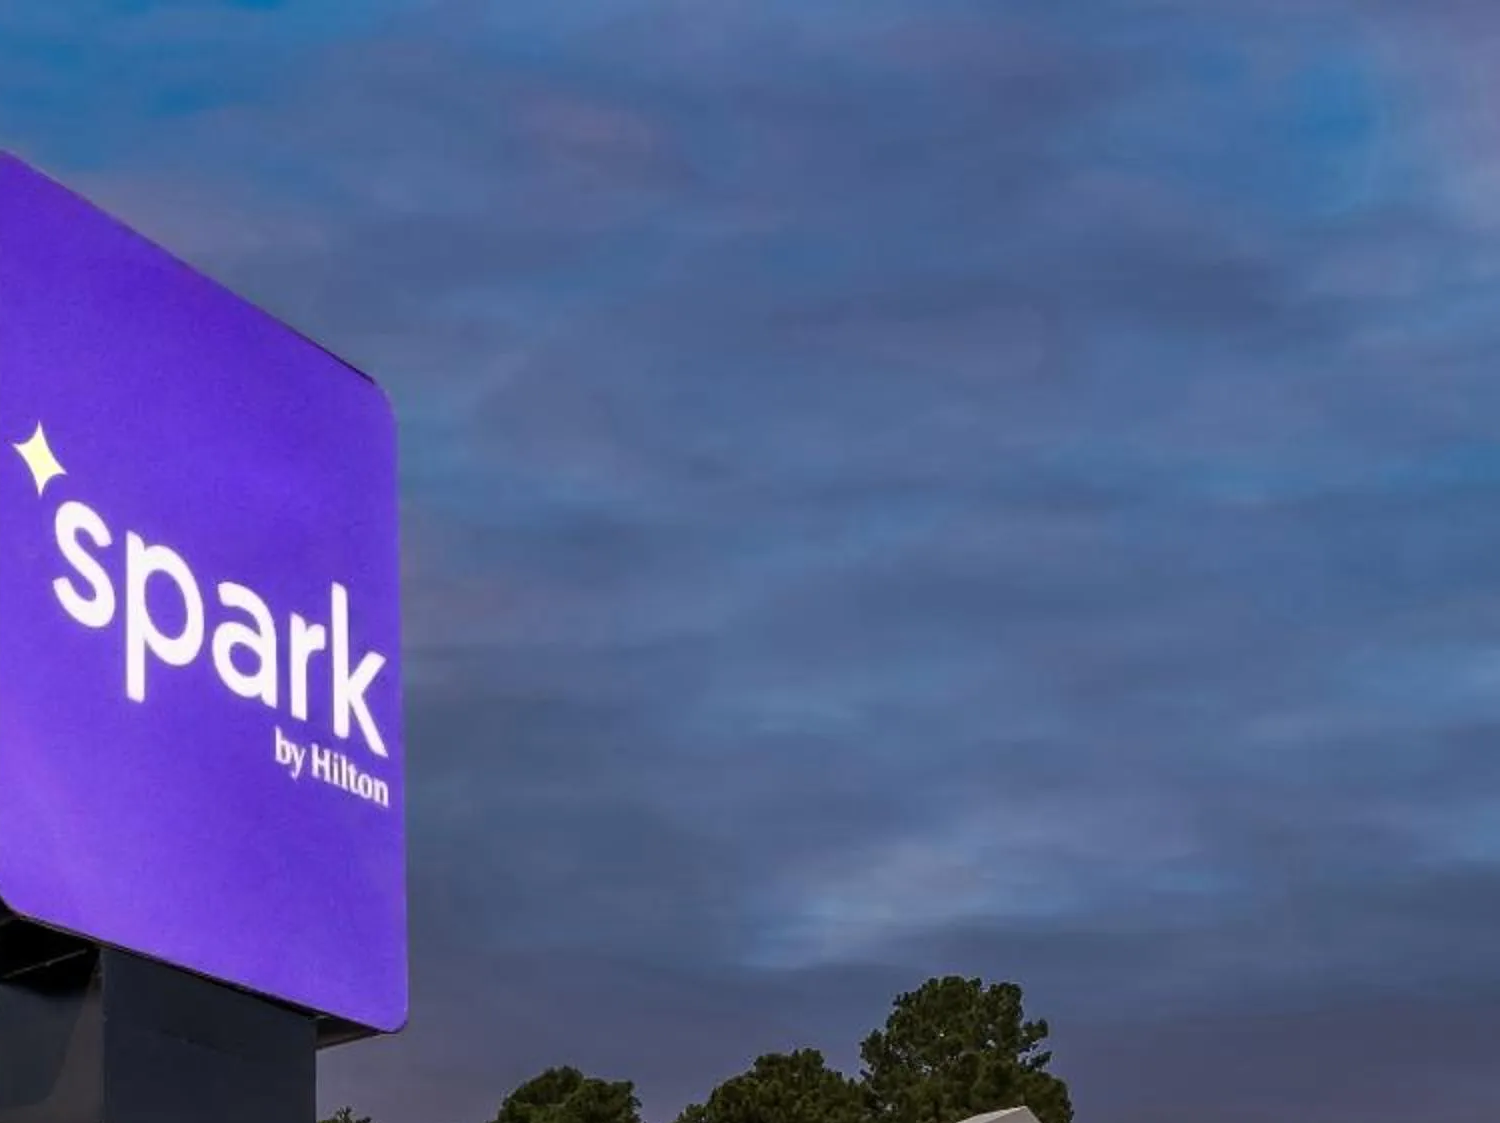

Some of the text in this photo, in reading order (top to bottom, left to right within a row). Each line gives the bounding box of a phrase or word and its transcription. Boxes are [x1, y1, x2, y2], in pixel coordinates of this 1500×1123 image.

[53, 500, 389, 758] spark
[275, 725, 389, 808] by Hilton
